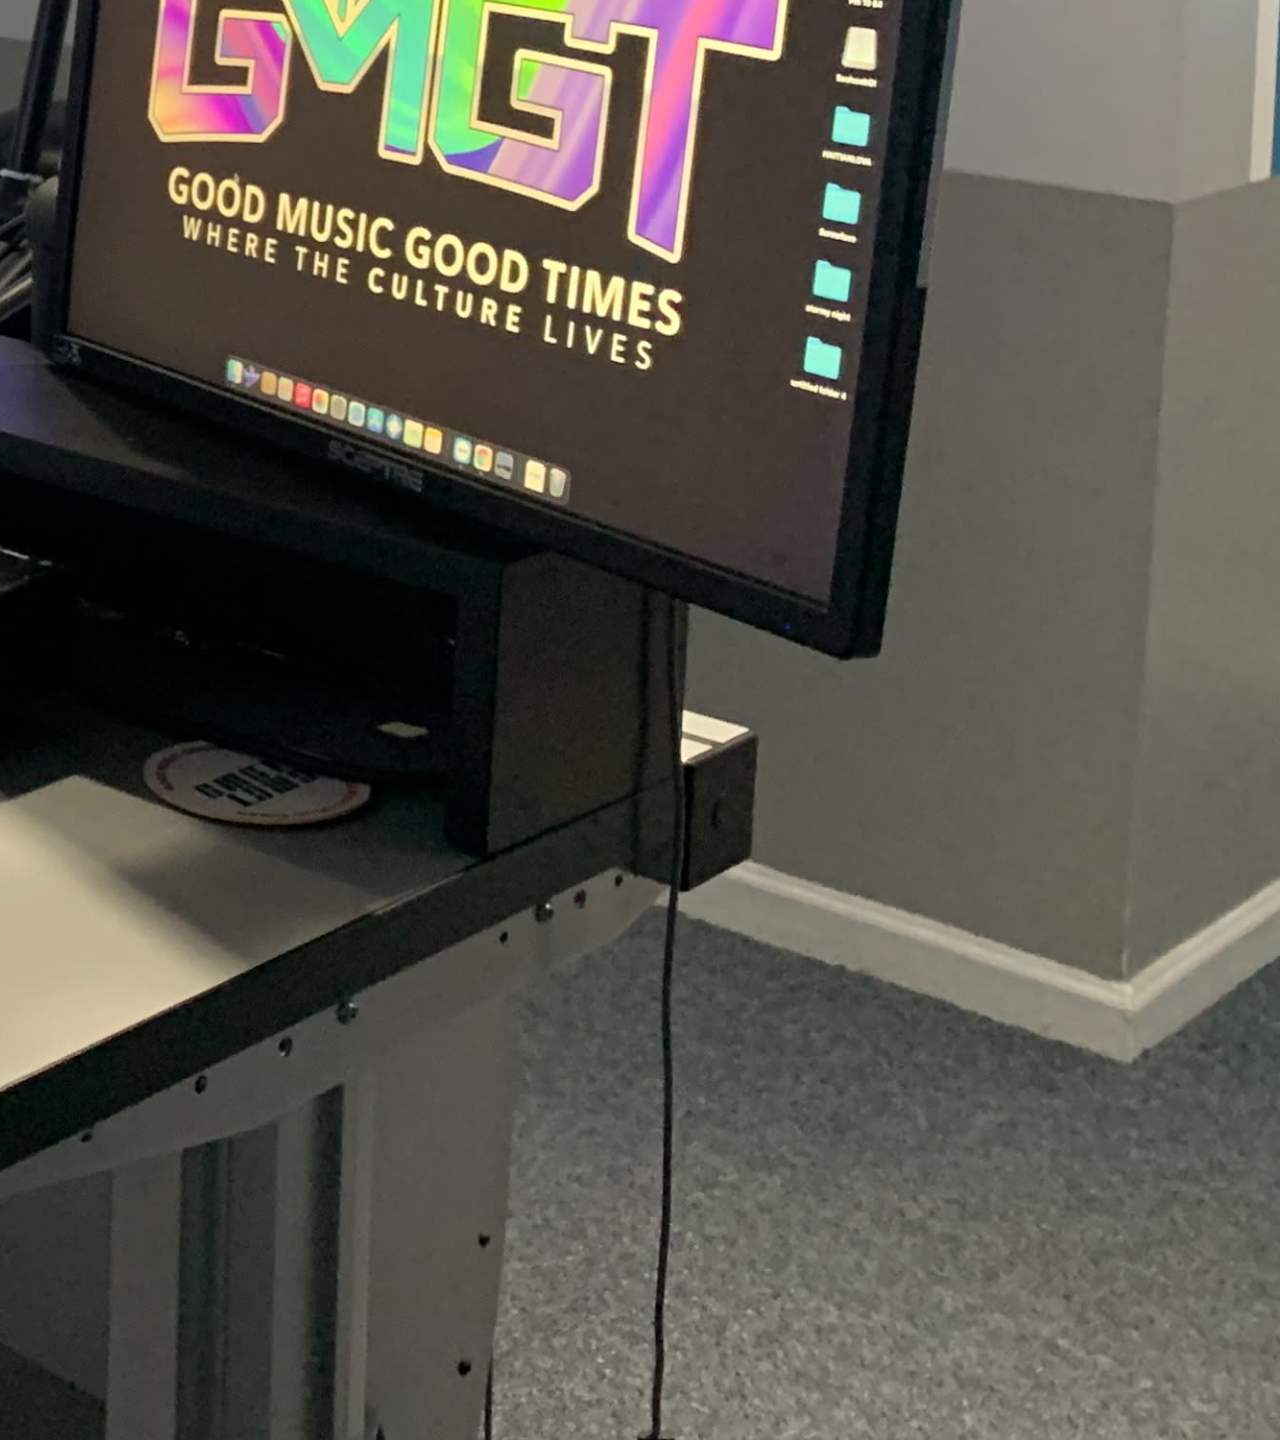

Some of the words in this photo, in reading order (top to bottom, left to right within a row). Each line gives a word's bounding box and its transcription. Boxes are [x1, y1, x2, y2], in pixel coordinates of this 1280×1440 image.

[167, 165, 267, 224] GOOD
[275, 192, 396, 260] MUSIC
[404, 226, 530, 294] GOOD
[541, 258, 684, 337] TIMES
[181, 214, 278, 265] WHERE
[294, 245, 350, 285] THE
[366, 266, 524, 334] CULTURE
[542, 314, 655, 371] LIVES
